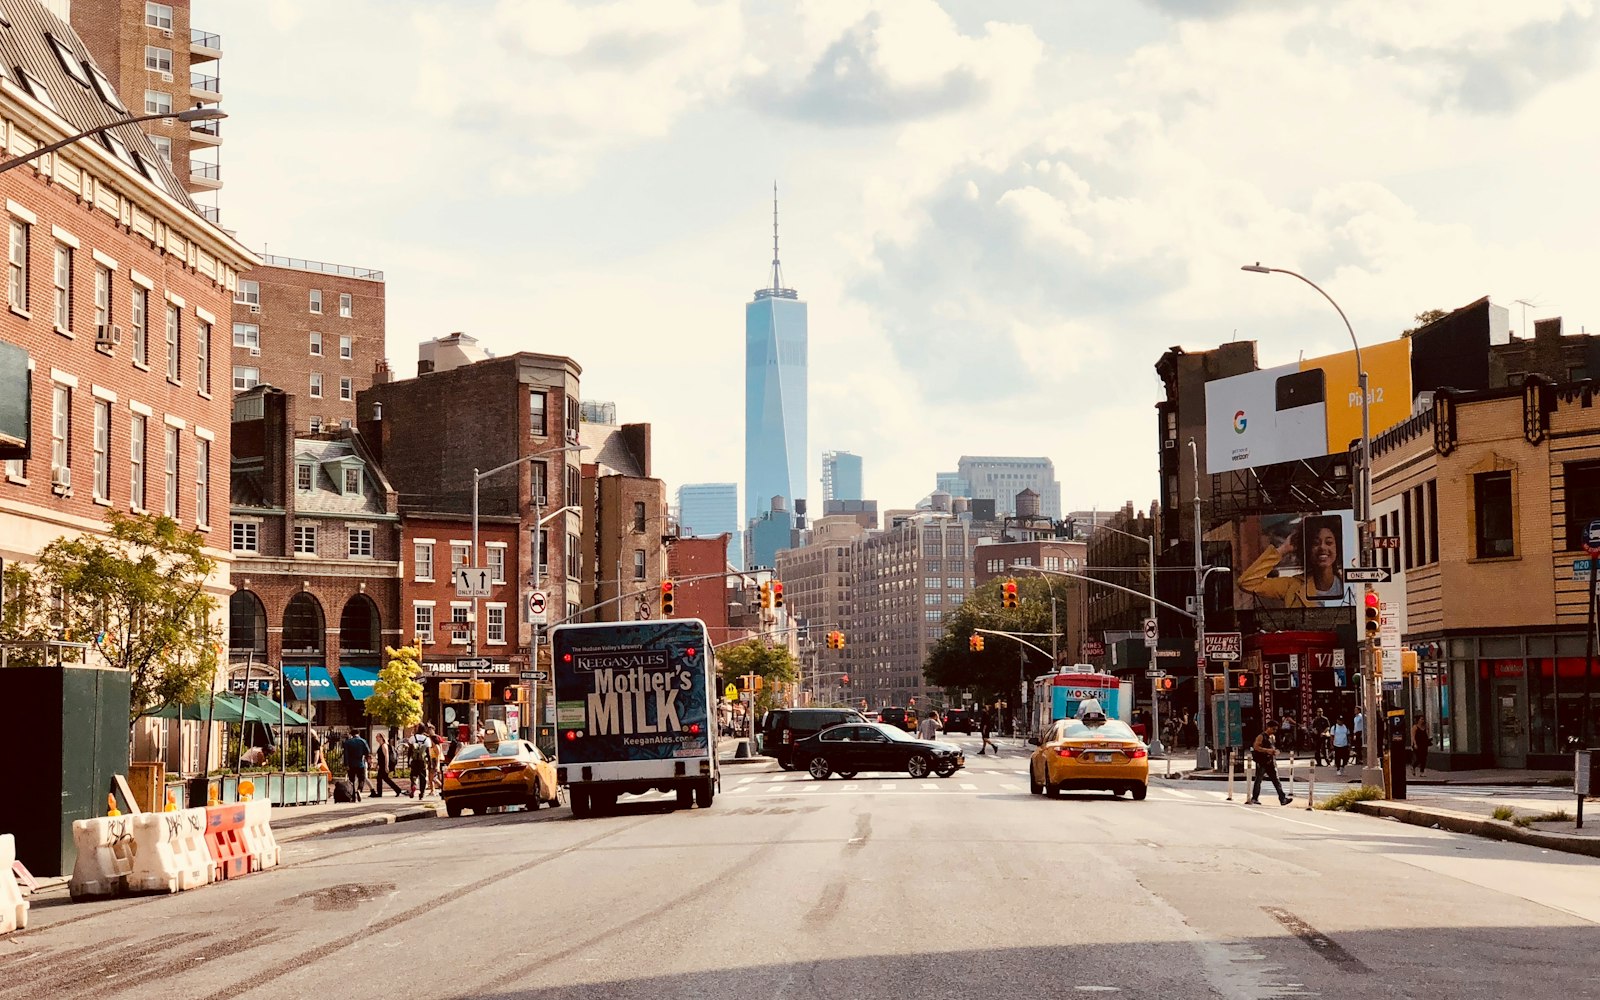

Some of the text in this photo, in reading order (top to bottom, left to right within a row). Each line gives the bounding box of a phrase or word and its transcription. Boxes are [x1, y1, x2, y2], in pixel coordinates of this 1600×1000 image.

[1376, 387, 1384, 403] 2
[1233, 410, 1247, 434] G
[1231, 453, 1249, 461] verizon
[1373, 538, 1399, 548] W 4 ST
[422, 663, 472, 673] TARBU
[577, 654, 664, 670] KEEGAN ALES
[1314, 653, 1335, 668] VI
[594, 664, 692, 694] Mother's
[587, 689, 682, 736] MILK
[1393, 717, 1400, 726] P
